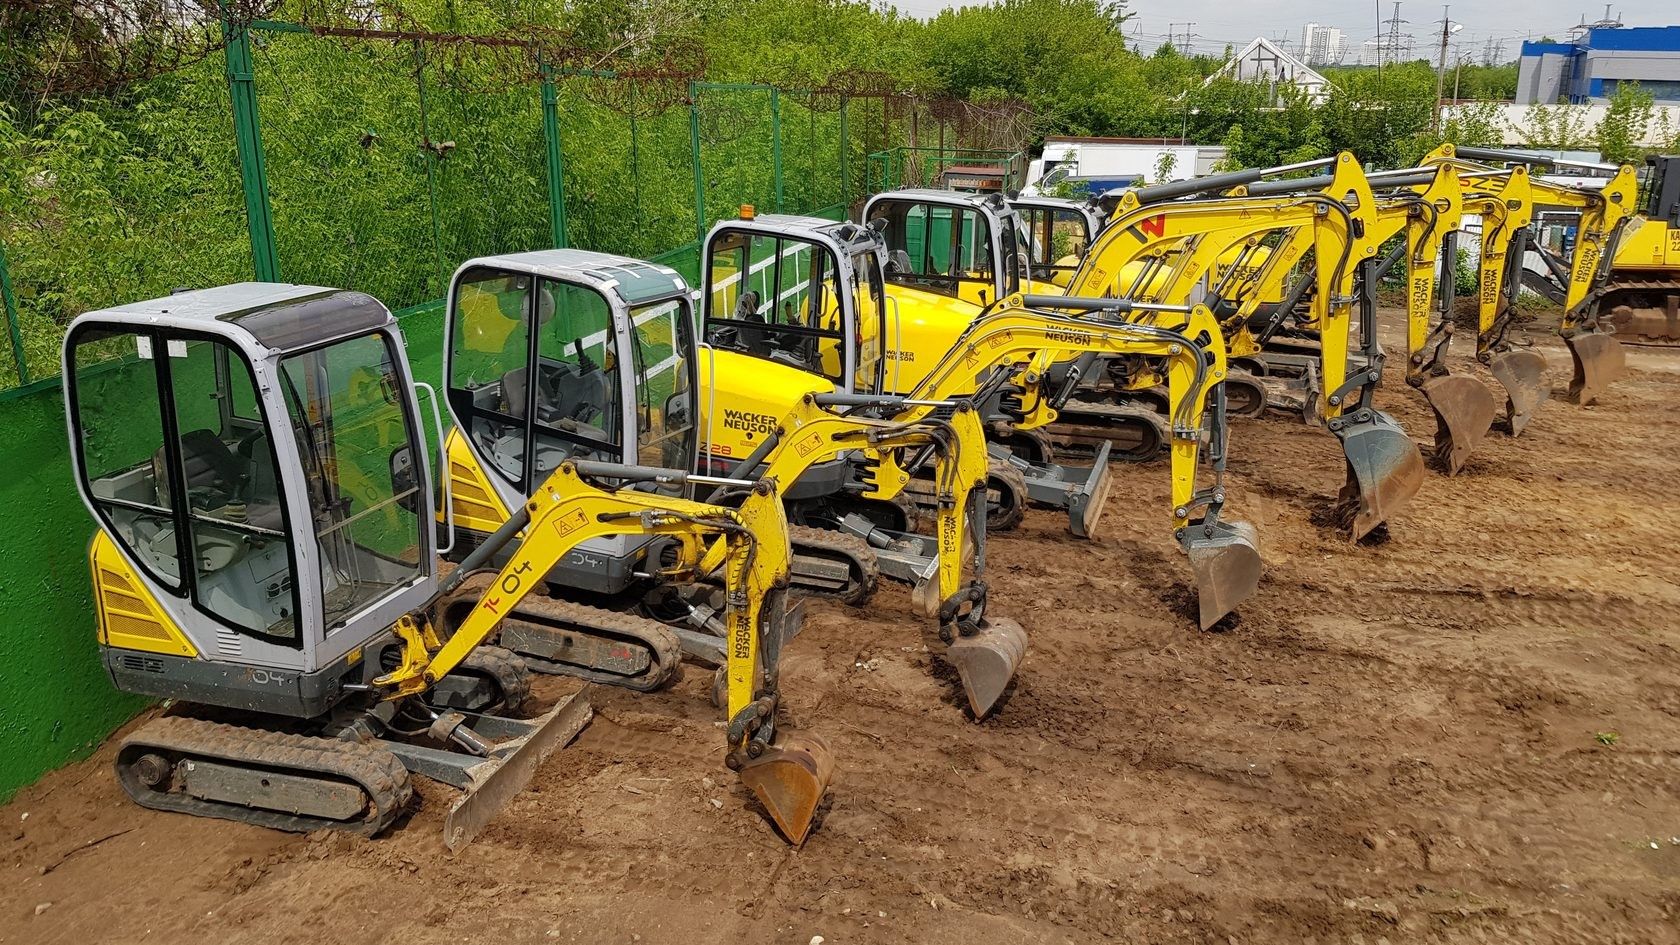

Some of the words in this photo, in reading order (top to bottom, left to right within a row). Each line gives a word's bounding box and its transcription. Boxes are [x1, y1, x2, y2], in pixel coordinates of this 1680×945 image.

[1574, 248, 1592, 282] NEUSON
[1420, 278, 1429, 318] WACKR
[1482, 269, 1491, 304] NEUSON
[1489, 269, 1497, 304] WACKER
[1045, 332, 1091, 346] NEUSON
[724, 409, 778, 426] WACKER
[724, 419, 778, 435] NEUSON
[501, 560, 532, 595] 04
[735, 614, 744, 659] NEUSON
[741, 617, 751, 659] WACKER
[252, 670, 285, 687] 04
